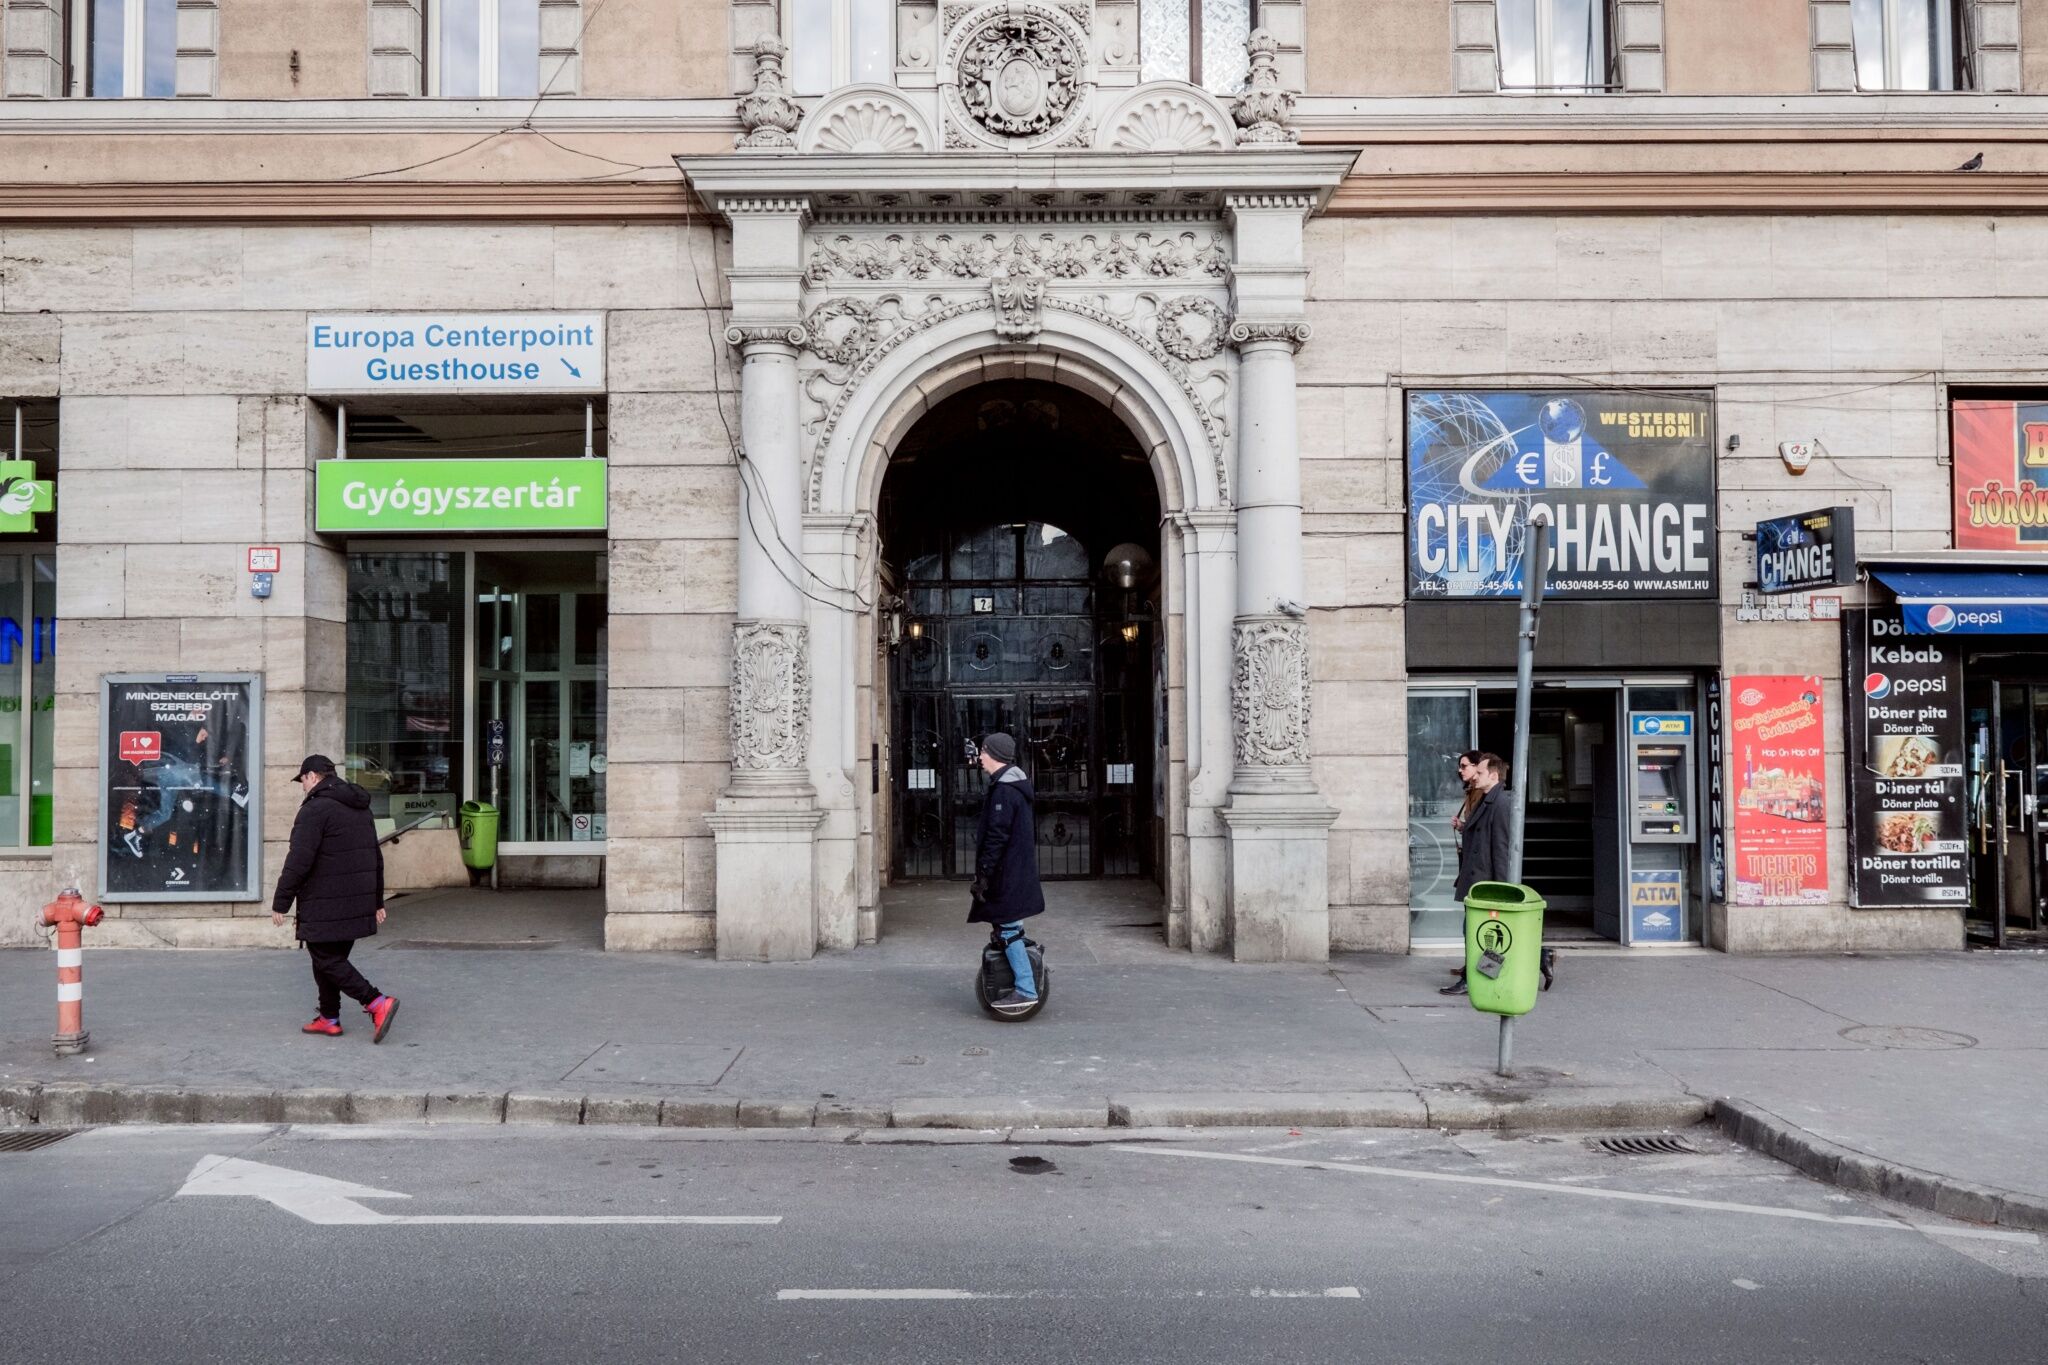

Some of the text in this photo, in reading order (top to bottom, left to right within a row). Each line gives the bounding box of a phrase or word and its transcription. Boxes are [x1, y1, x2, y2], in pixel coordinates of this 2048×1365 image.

[313, 323, 594, 353] Europa Centerpoint
[366, 358, 540, 381] Guesthouse
[1600, 412, 1690, 425] WESTERN
[1629, 425, 1690, 438] UNION
[342, 476, 582, 516] Gyógyszertár
[1968, 481, 2048, 524] TÖRÖK
[1417, 502, 1517, 574] CITY
[1760, 543, 1833, 585] CHANGE
[1419, 581, 1445, 591] TEL.:
[1555, 580, 1629, 590] 0630/484-55-60
[1633, 580, 1710, 590] WWW.ASMI.HU
[1956, 610, 2003, 627] pepsi
[1871, 645, 1943, 664] Kebab
[1893, 675, 1947, 696] pepsi
[126, 691, 239, 701] MINDENEKELŐTT
[150, 702, 213, 711] SZERESD
[1868, 705, 1948, 722] Döner pita
[155, 713, 207, 722] MAGAD
[1759, 712, 1815, 739] Budapest
[1883, 723, 1935, 735] Döner pita
[131, 737, 137, 748] 1
[1761, 748, 1820, 757] Hop On Hop Off
[1924, 780, 1945, 795] tál
[404, 801, 427, 809] BENU
[1710, 701, 1723, 898] CHANGE
[1882, 797, 1939, 811] Döner plate
[1747, 854, 1816, 877] TICKETS
[1862, 856, 1961, 870] Döner tortilla
[1881, 873, 1943, 884] Döner tortilla
[1636, 887, 1677, 901] ATM
[1762, 876, 1804, 897] HERE
